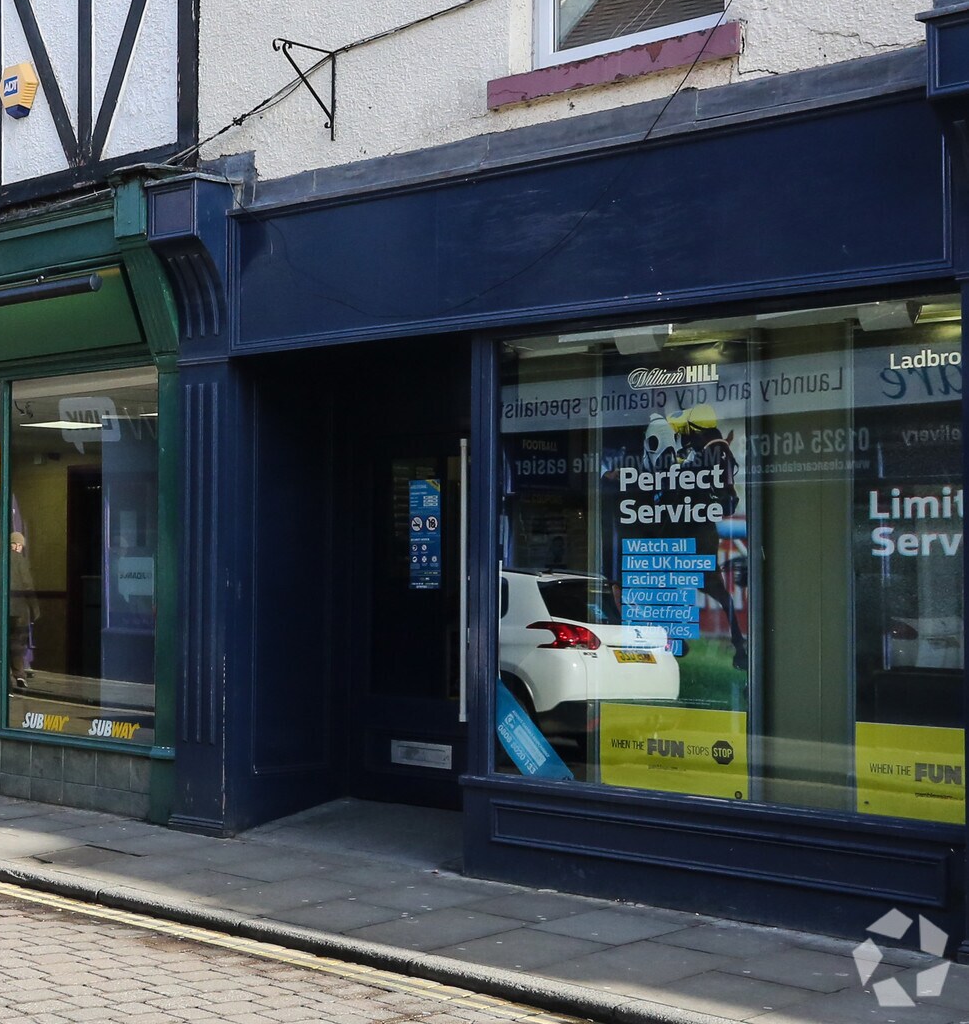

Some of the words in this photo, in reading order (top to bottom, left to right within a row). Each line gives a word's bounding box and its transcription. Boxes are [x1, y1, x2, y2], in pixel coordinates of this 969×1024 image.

[4, 79, 18, 94] ADT
[890, 349, 962, 370] Ladbro
[628, 367, 685, 390] William
[686, 363, 719, 383] HILL
[619, 464, 724, 491] Perfect
[619, 496, 724, 524] Service
[627, 539, 669, 552] Watch
[672, 539, 687, 552] all
[871, 527, 963, 557] Serv
[627, 557, 649, 569] live
[652, 557, 671, 569] UK
[674, 557, 712, 569] horse
[627, 573, 667, 587] racing
[669, 573, 699, 586] here
[626, 588, 654, 604] (you
[656, 589, 688, 602] can't
[643, 605, 694, 621] Betfred,
[22, 712, 70, 732] SUBWAY
[88, 719, 140, 739] SUBWAY
[611, 738, 631, 749] WHEN
[632, 740, 645, 751] THE
[647, 738, 685, 758] FUN
[687, 745, 710, 757] STOPS
[712, 747, 733, 758] STOP
[869, 762, 893, 775] WHEN
[896, 764, 912, 776] THE
[914, 762, 963, 785] FUN
